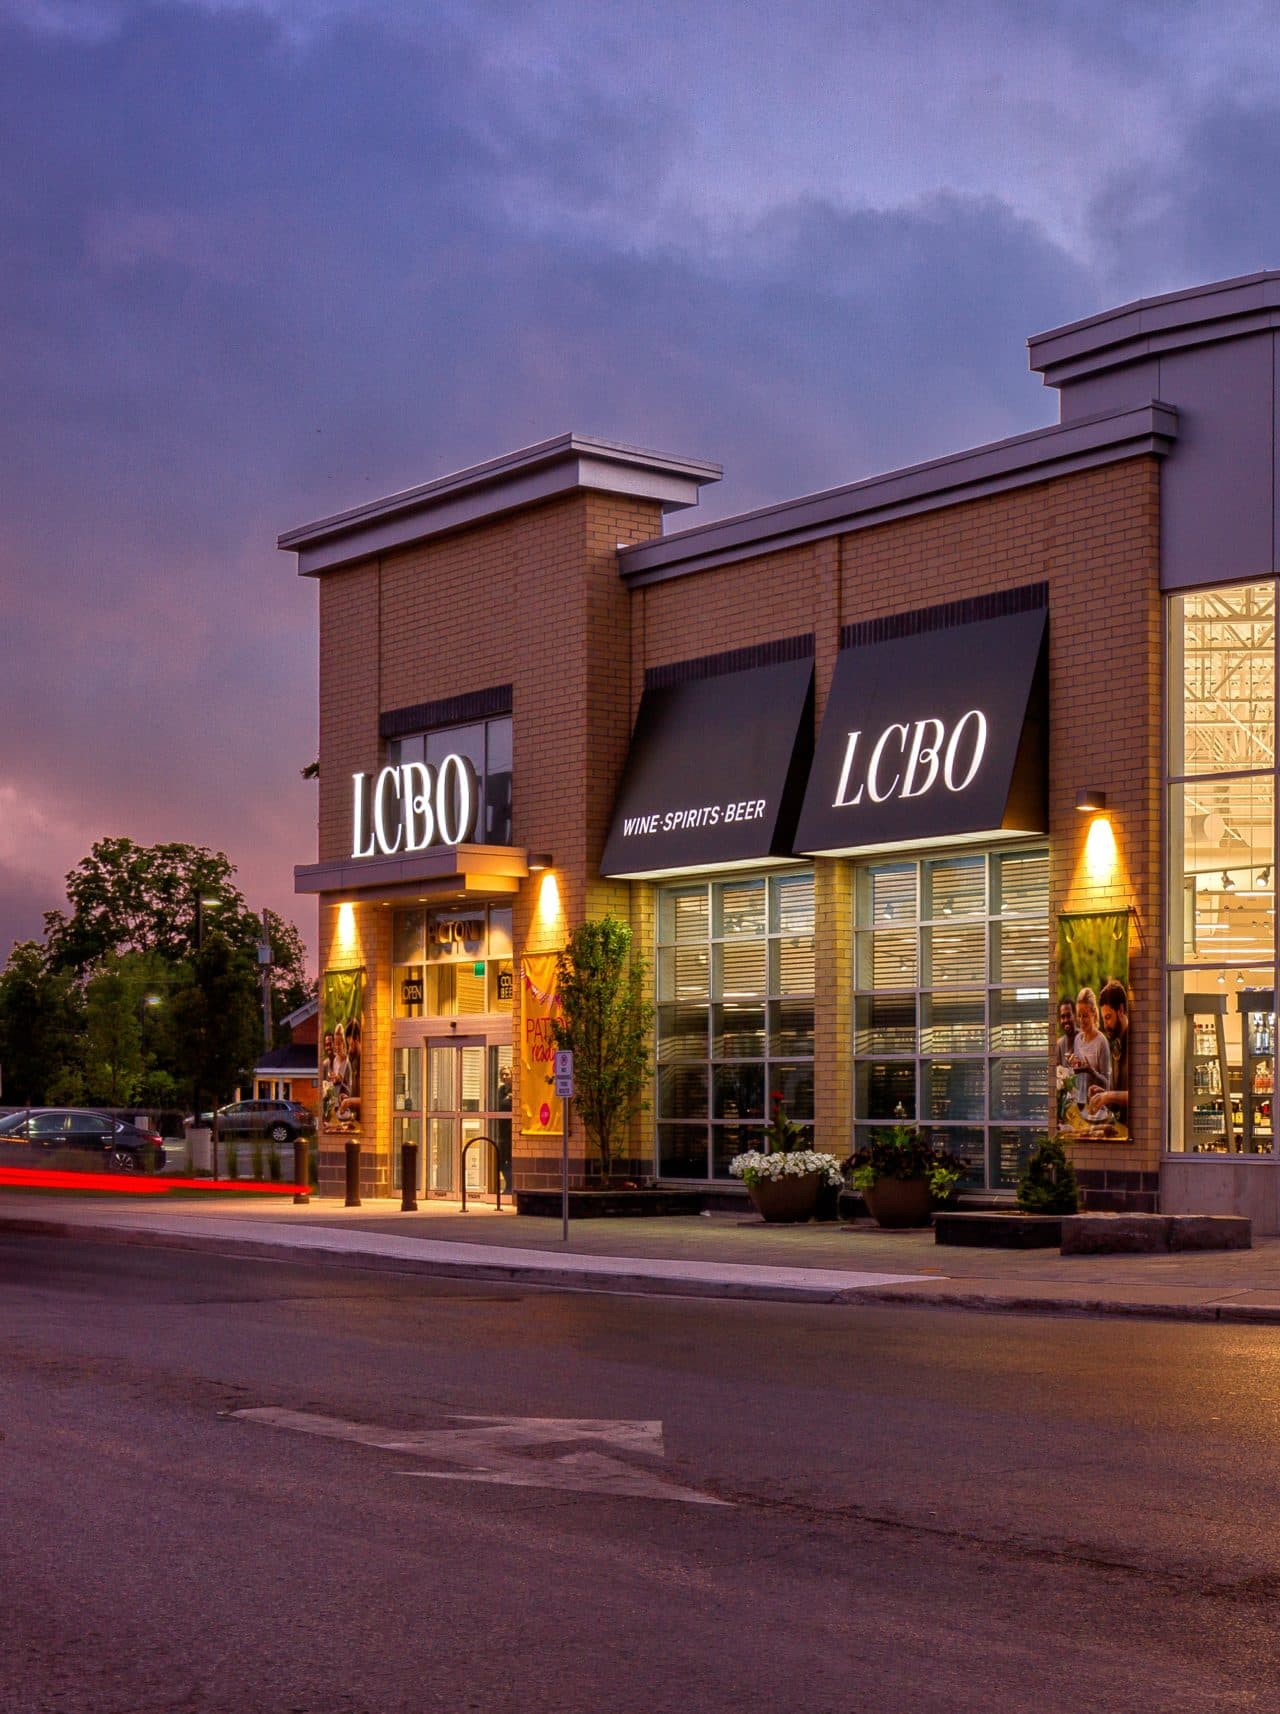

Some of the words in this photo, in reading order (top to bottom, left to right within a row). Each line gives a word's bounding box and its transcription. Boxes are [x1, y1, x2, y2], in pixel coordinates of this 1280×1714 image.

[351, 753, 470, 859] LCBO
[831, 709, 987, 808] LCBO
[402, 985, 422, 1000] OPEN
